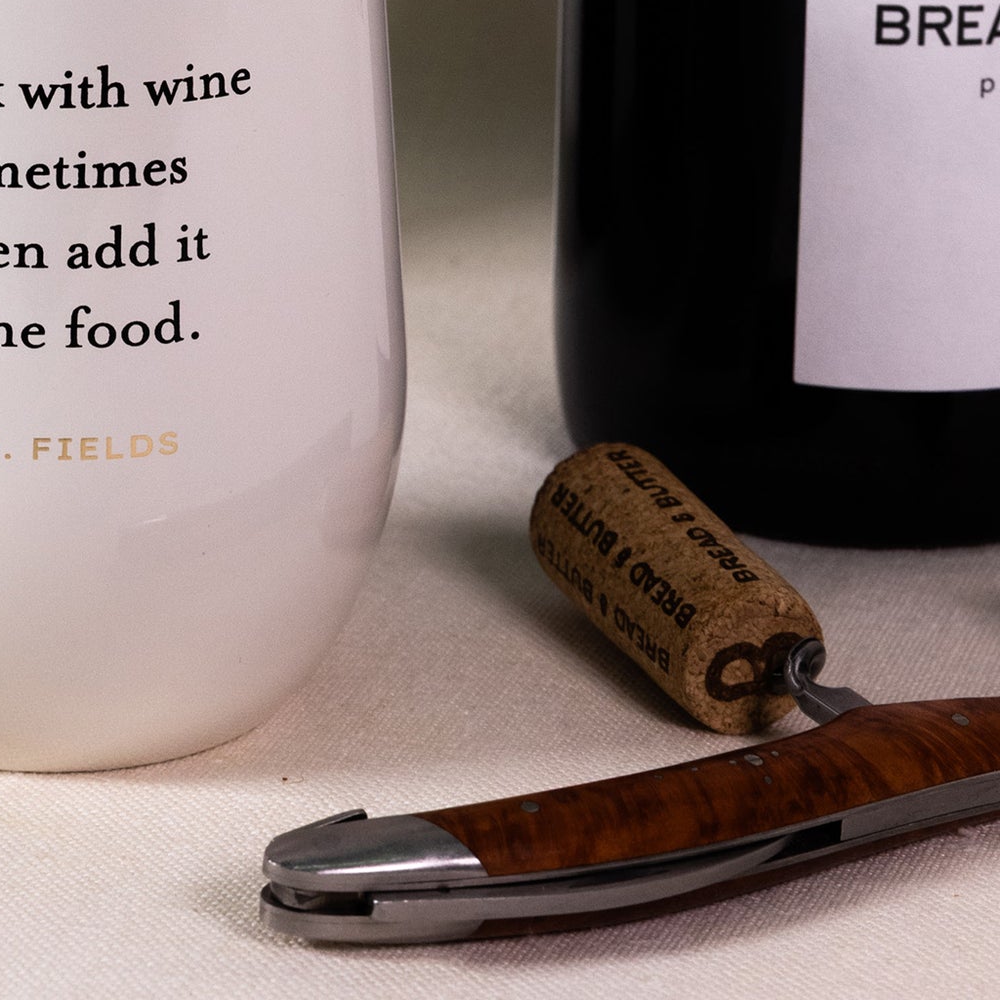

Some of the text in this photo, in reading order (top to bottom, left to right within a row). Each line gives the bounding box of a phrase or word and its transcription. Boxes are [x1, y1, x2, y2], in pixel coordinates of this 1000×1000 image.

[17, 64, 130, 111] with
[142, 63, 253, 107] wine
[65, 221, 160, 270] add
[176, 223, 212, 264] it
[64, 299, 201, 350] food.
[31, 431, 180, 462] FIELDS
[606, 449, 683, 509] BUTTER
[550, 483, 619, 557] BUTTER
[685, 526, 760, 584] BREAD
[629, 561, 697, 630] BREAD
[613, 605, 671, 675] BREAD
